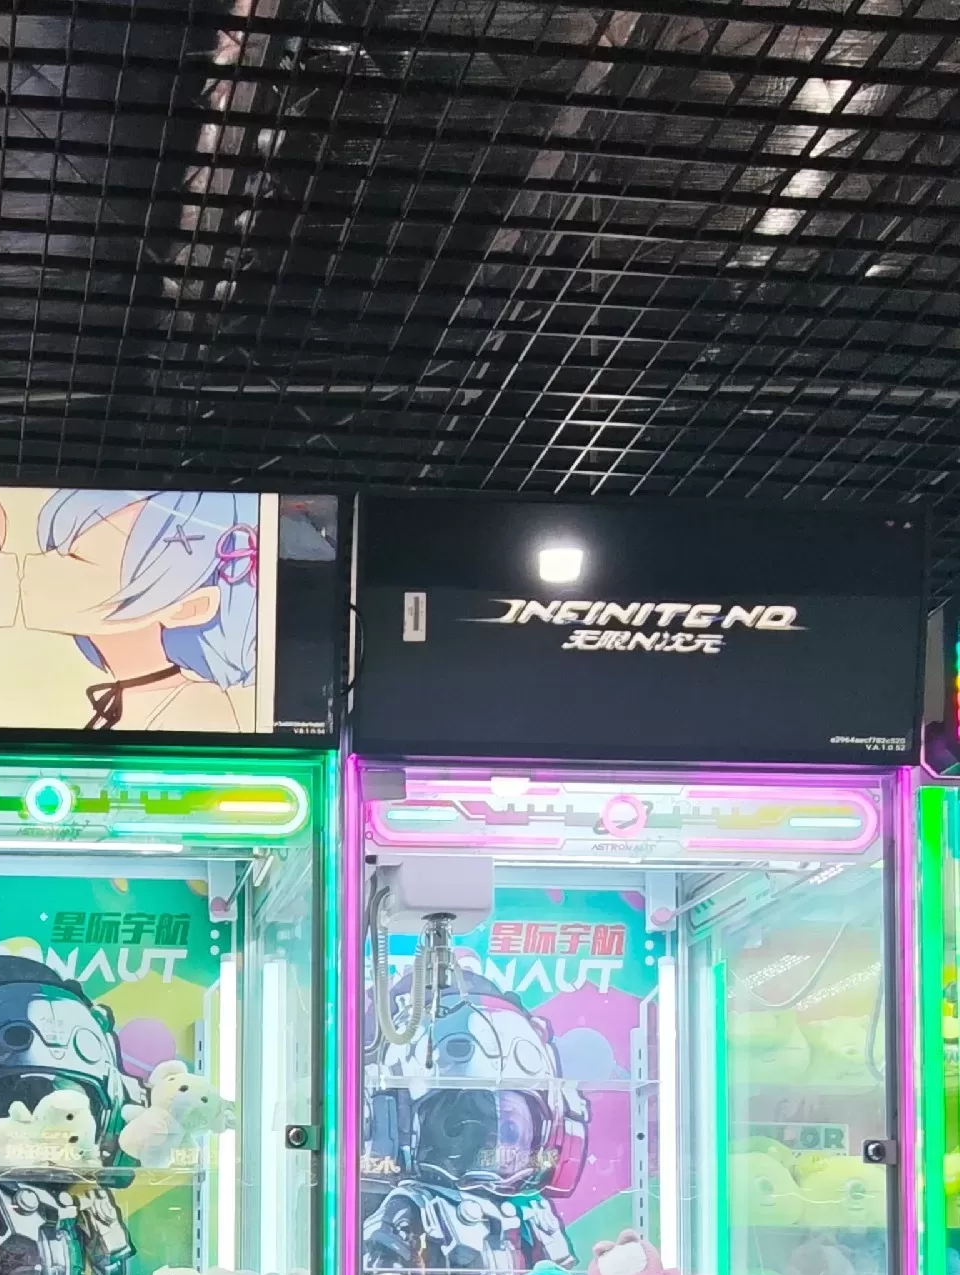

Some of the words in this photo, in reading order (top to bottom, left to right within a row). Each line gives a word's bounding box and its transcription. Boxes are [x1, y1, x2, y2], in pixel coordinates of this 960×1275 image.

[50, 911, 191, 946] 星际宇航
[488, 921, 628, 956] 星际宇航
